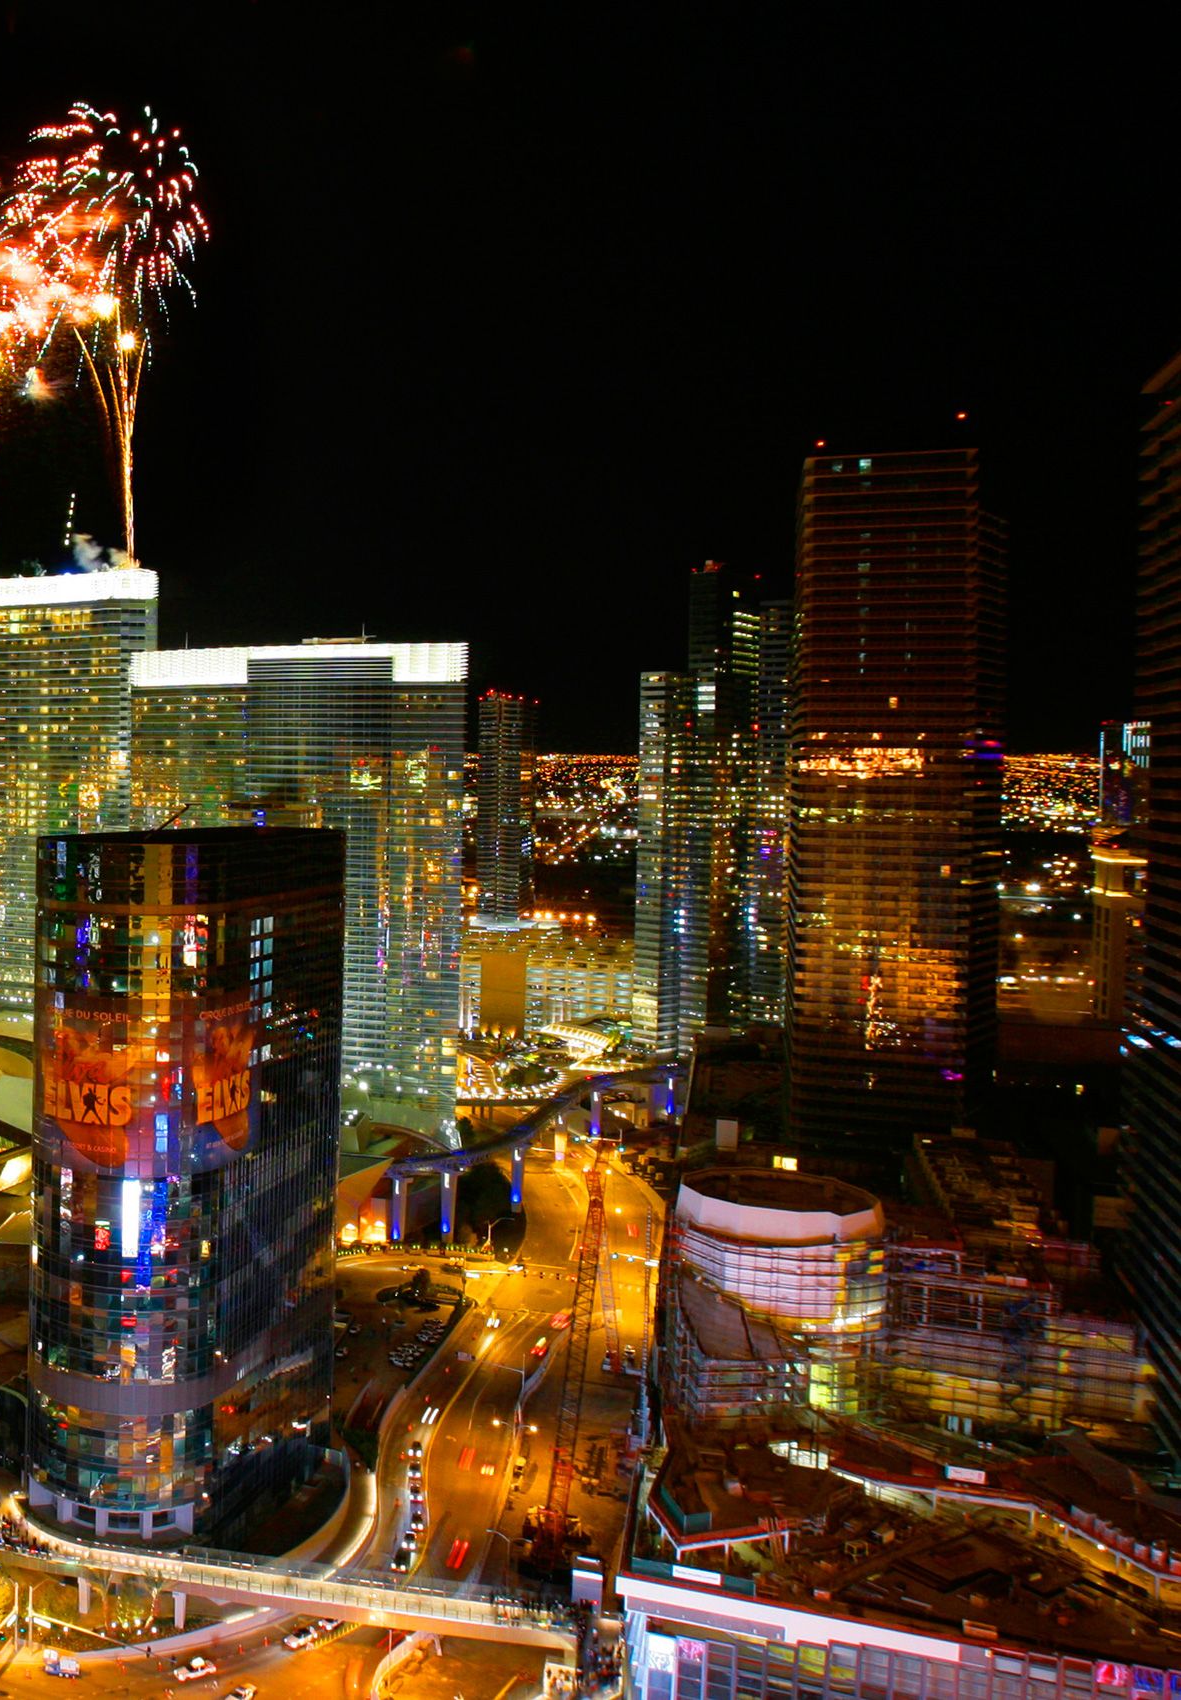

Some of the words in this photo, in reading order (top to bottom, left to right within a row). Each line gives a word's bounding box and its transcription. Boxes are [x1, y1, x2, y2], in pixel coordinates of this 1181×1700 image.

[45, 1004, 74, 1018] CQUE
[76, 1009, 91, 1020] DU
[93, 1011, 131, 1023] SOLEIL
[44, 1078, 132, 1127] ELVIS
[197, 1069, 251, 1124] ELVIS
